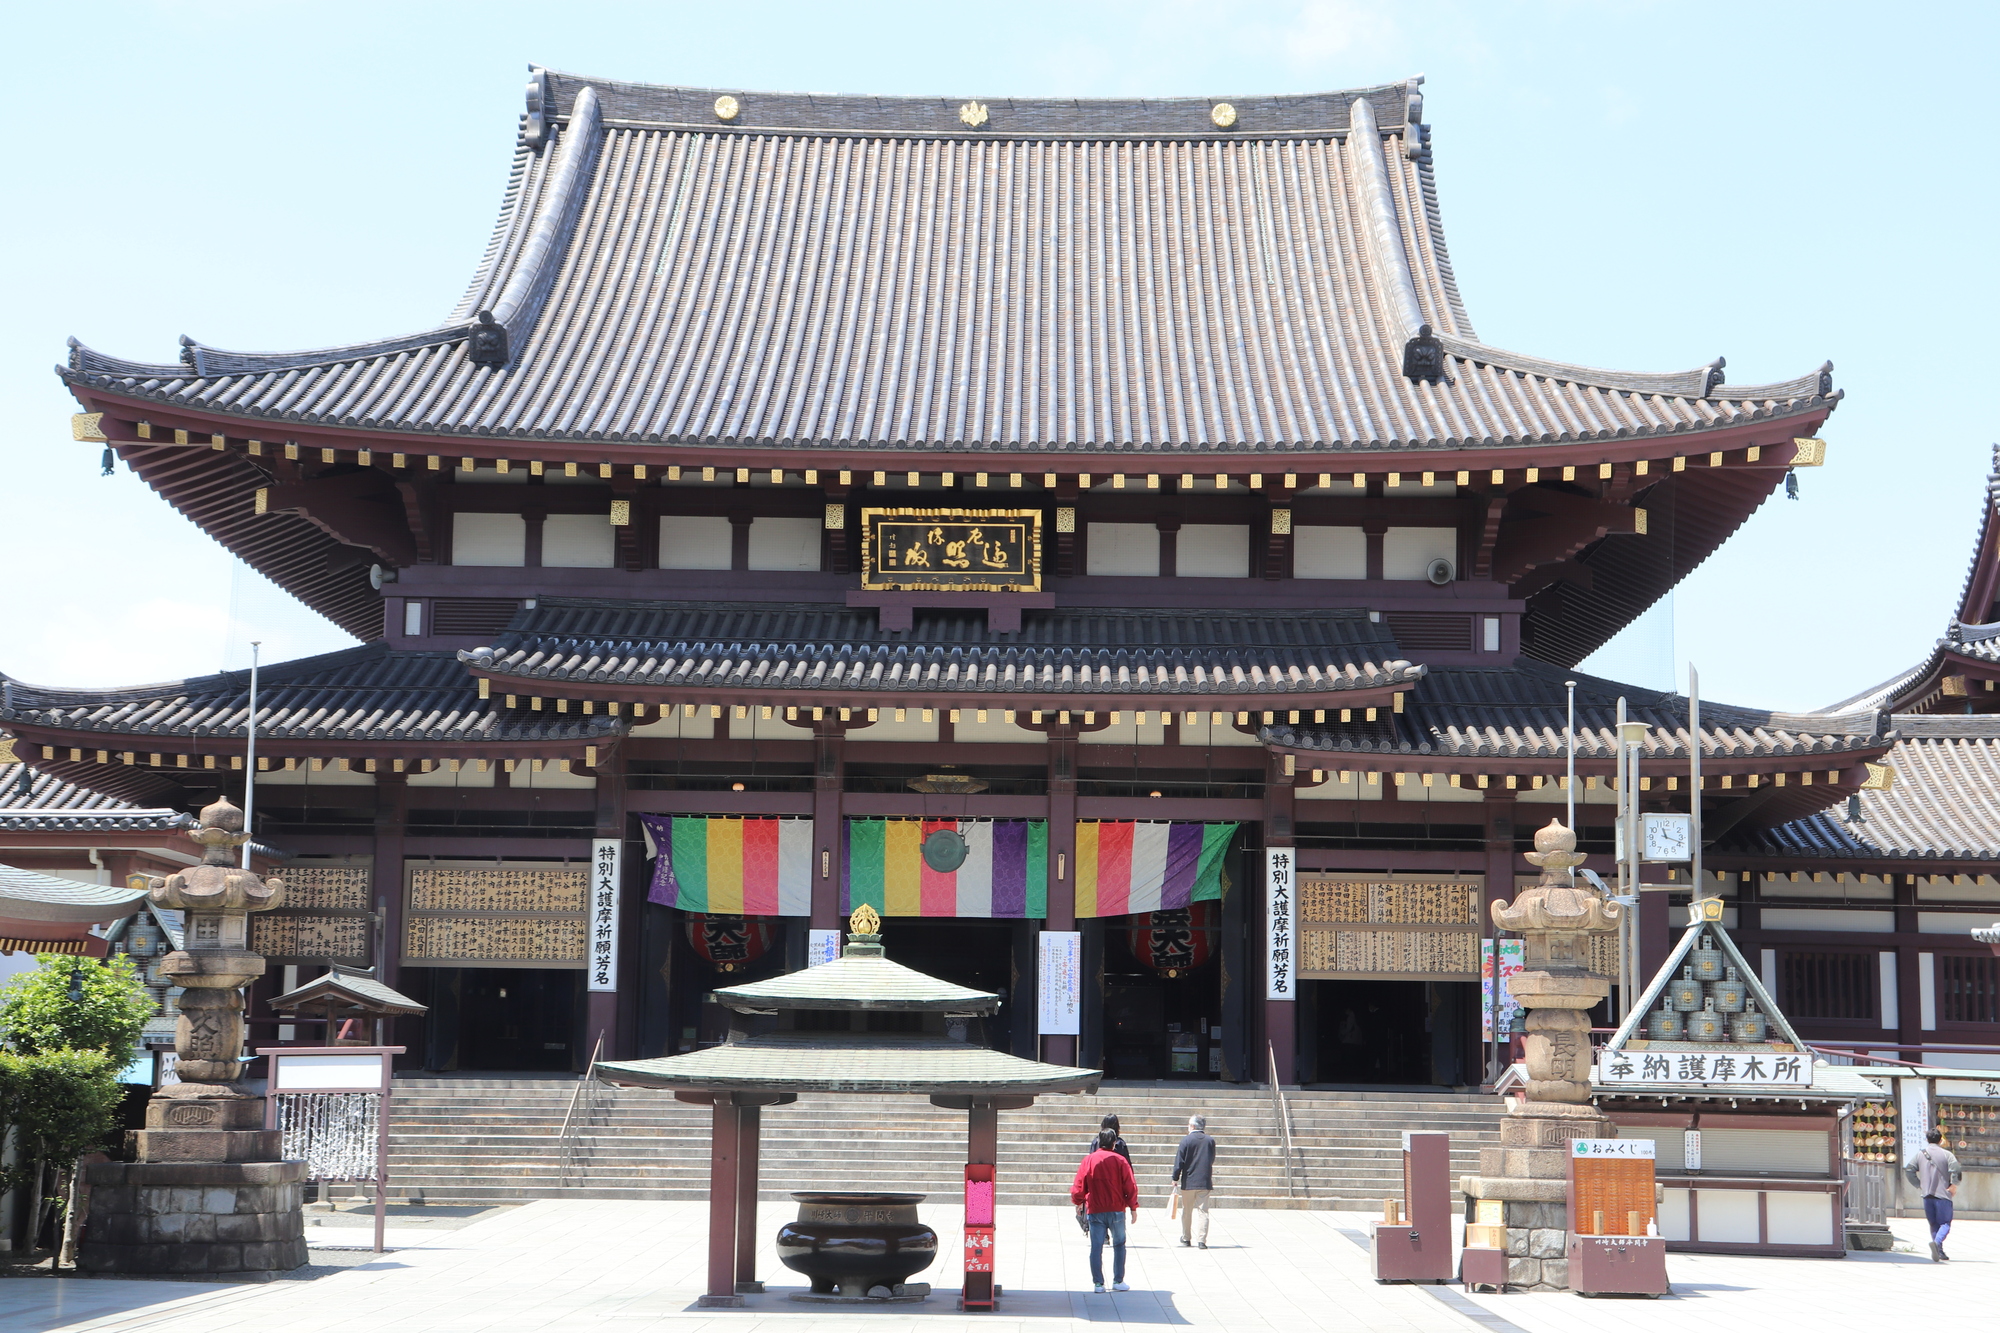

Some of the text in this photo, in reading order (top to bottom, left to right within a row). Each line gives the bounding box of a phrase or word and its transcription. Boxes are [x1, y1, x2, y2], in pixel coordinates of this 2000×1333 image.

[595, 846, 615, 984] 特別大護摩祈願芳名
[1272, 854, 1289, 993] 特別大護摩祈願芳名
[1609, 1053, 1801, 1082] 奉納護摩木所
[1593, 1143, 1637, 1155] おみくじ
[965, 1236, 993, 1248] 献香
